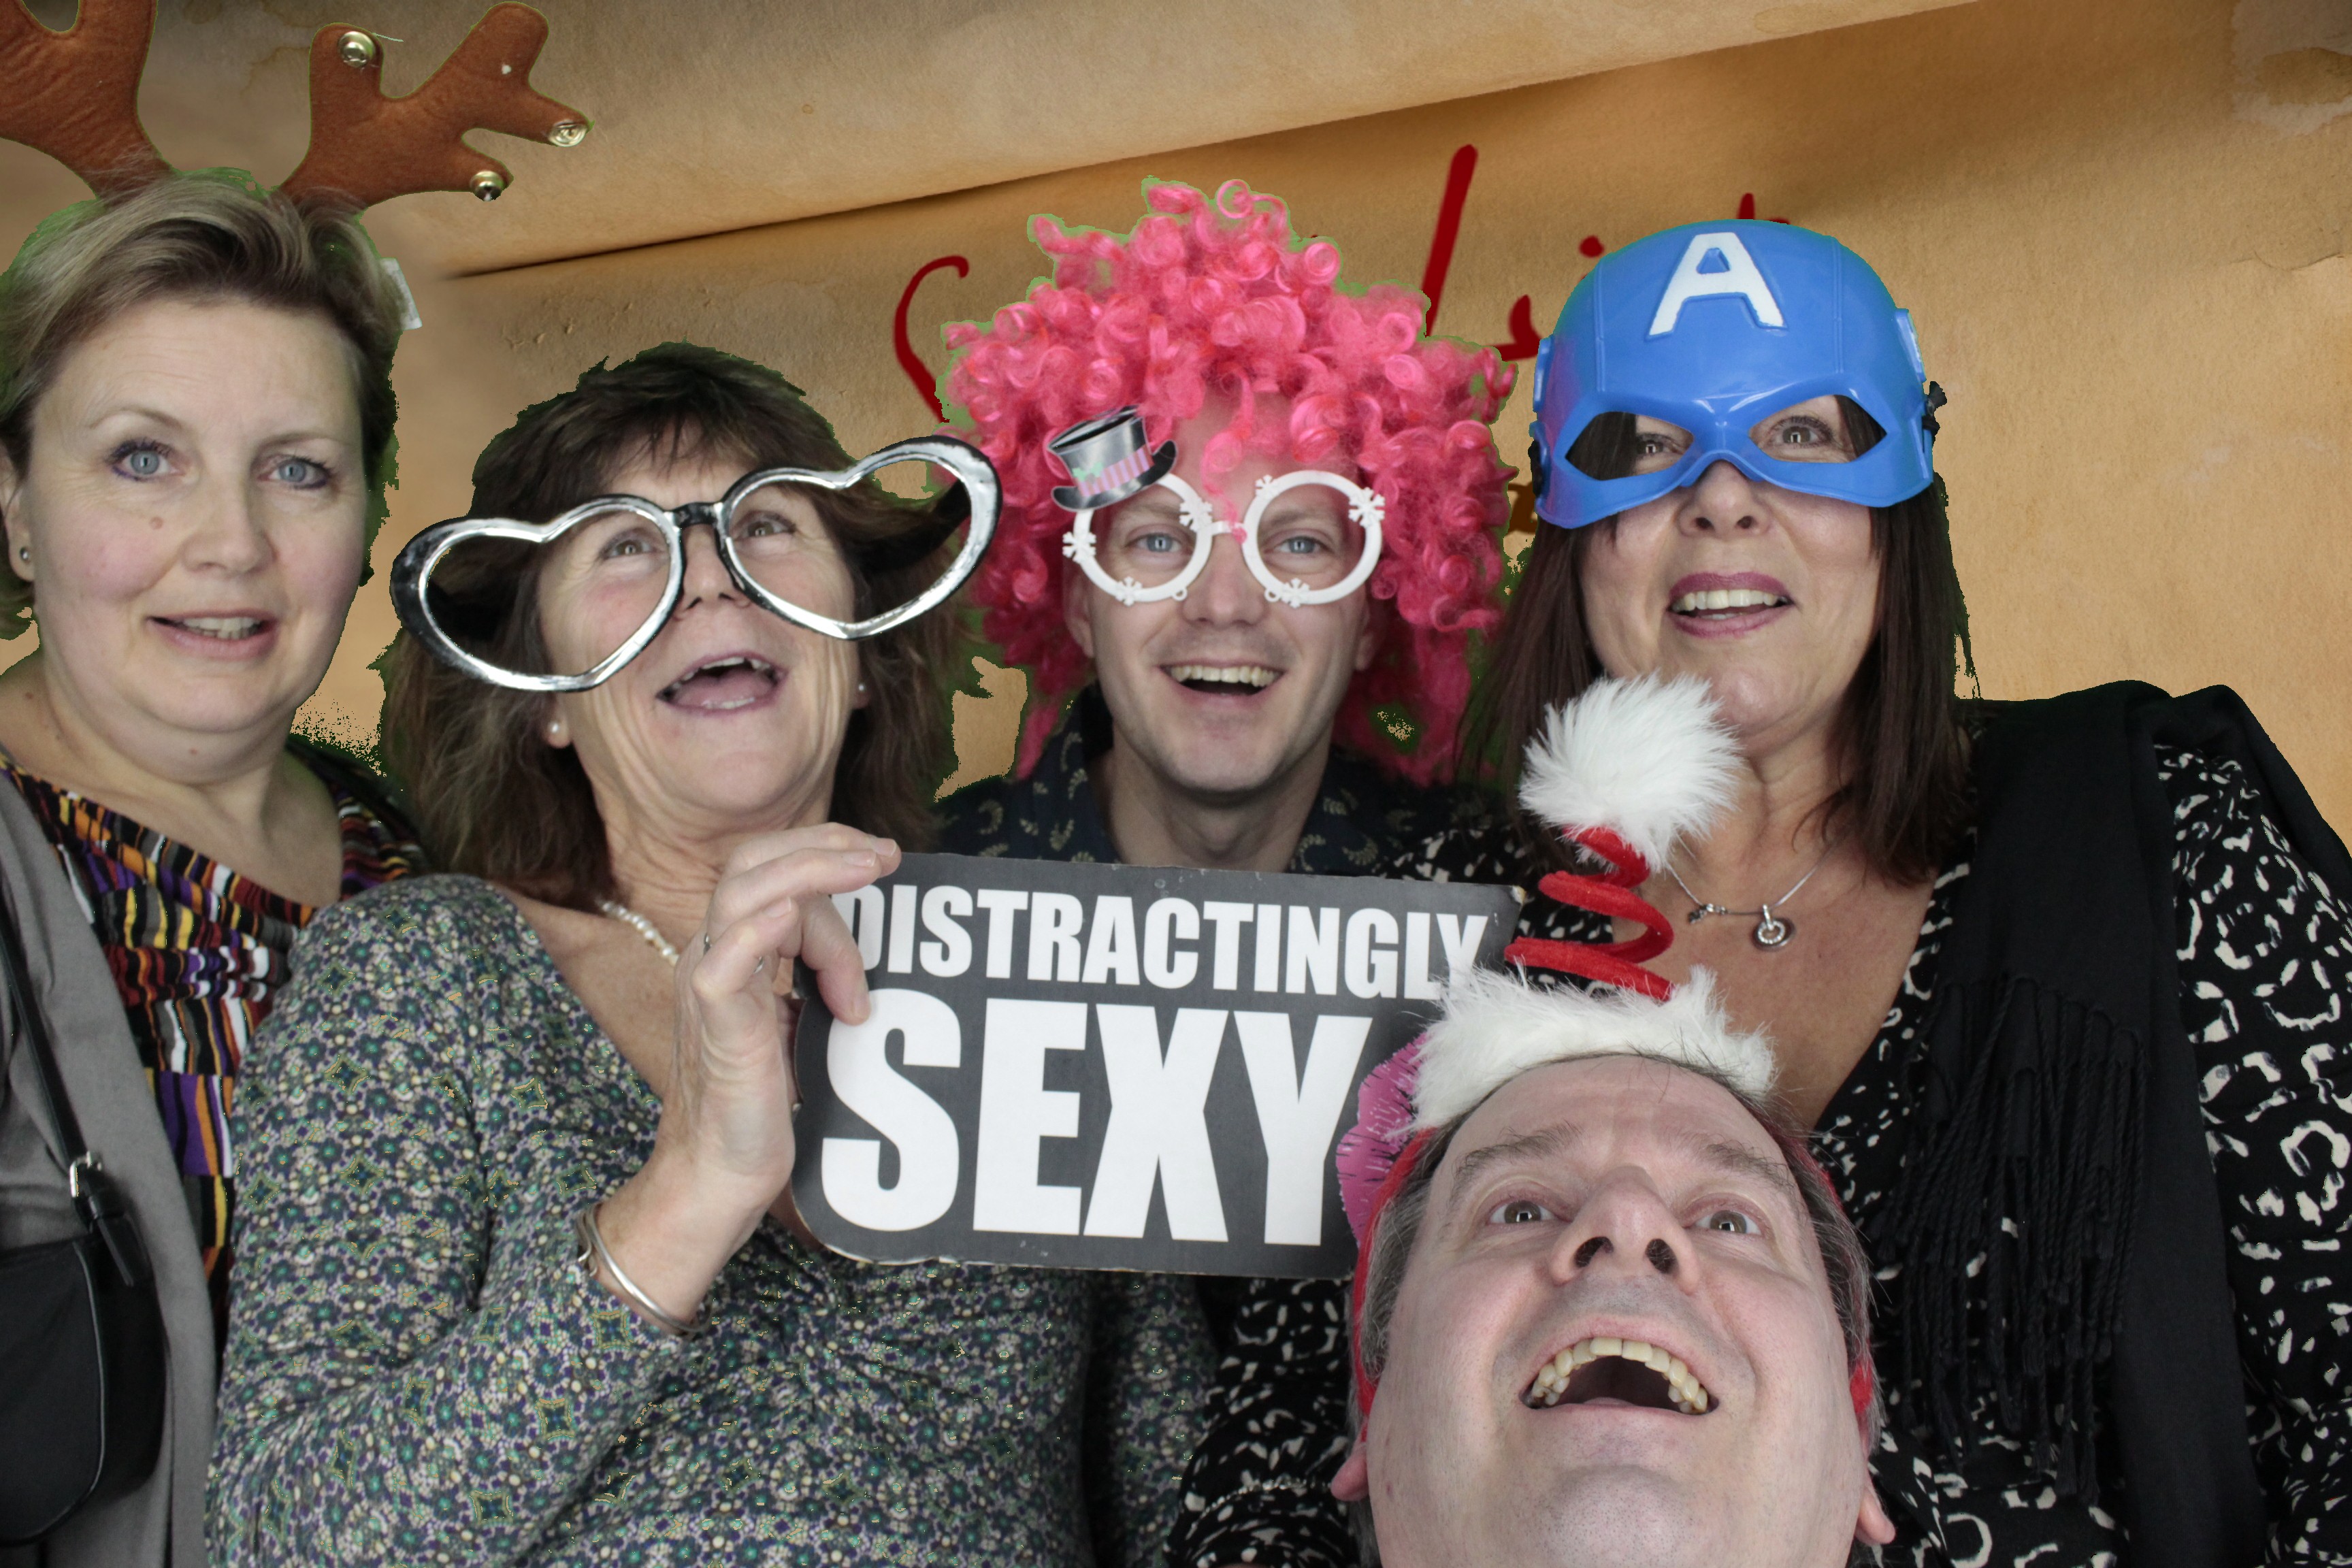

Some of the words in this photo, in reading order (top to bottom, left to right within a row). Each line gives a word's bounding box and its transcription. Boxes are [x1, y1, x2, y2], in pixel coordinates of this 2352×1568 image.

[1648, 232, 1784, 336] A
[831, 884, 1488, 1000] DISTRACTINGLY
[821, 988, 1373, 1246] SEXY
